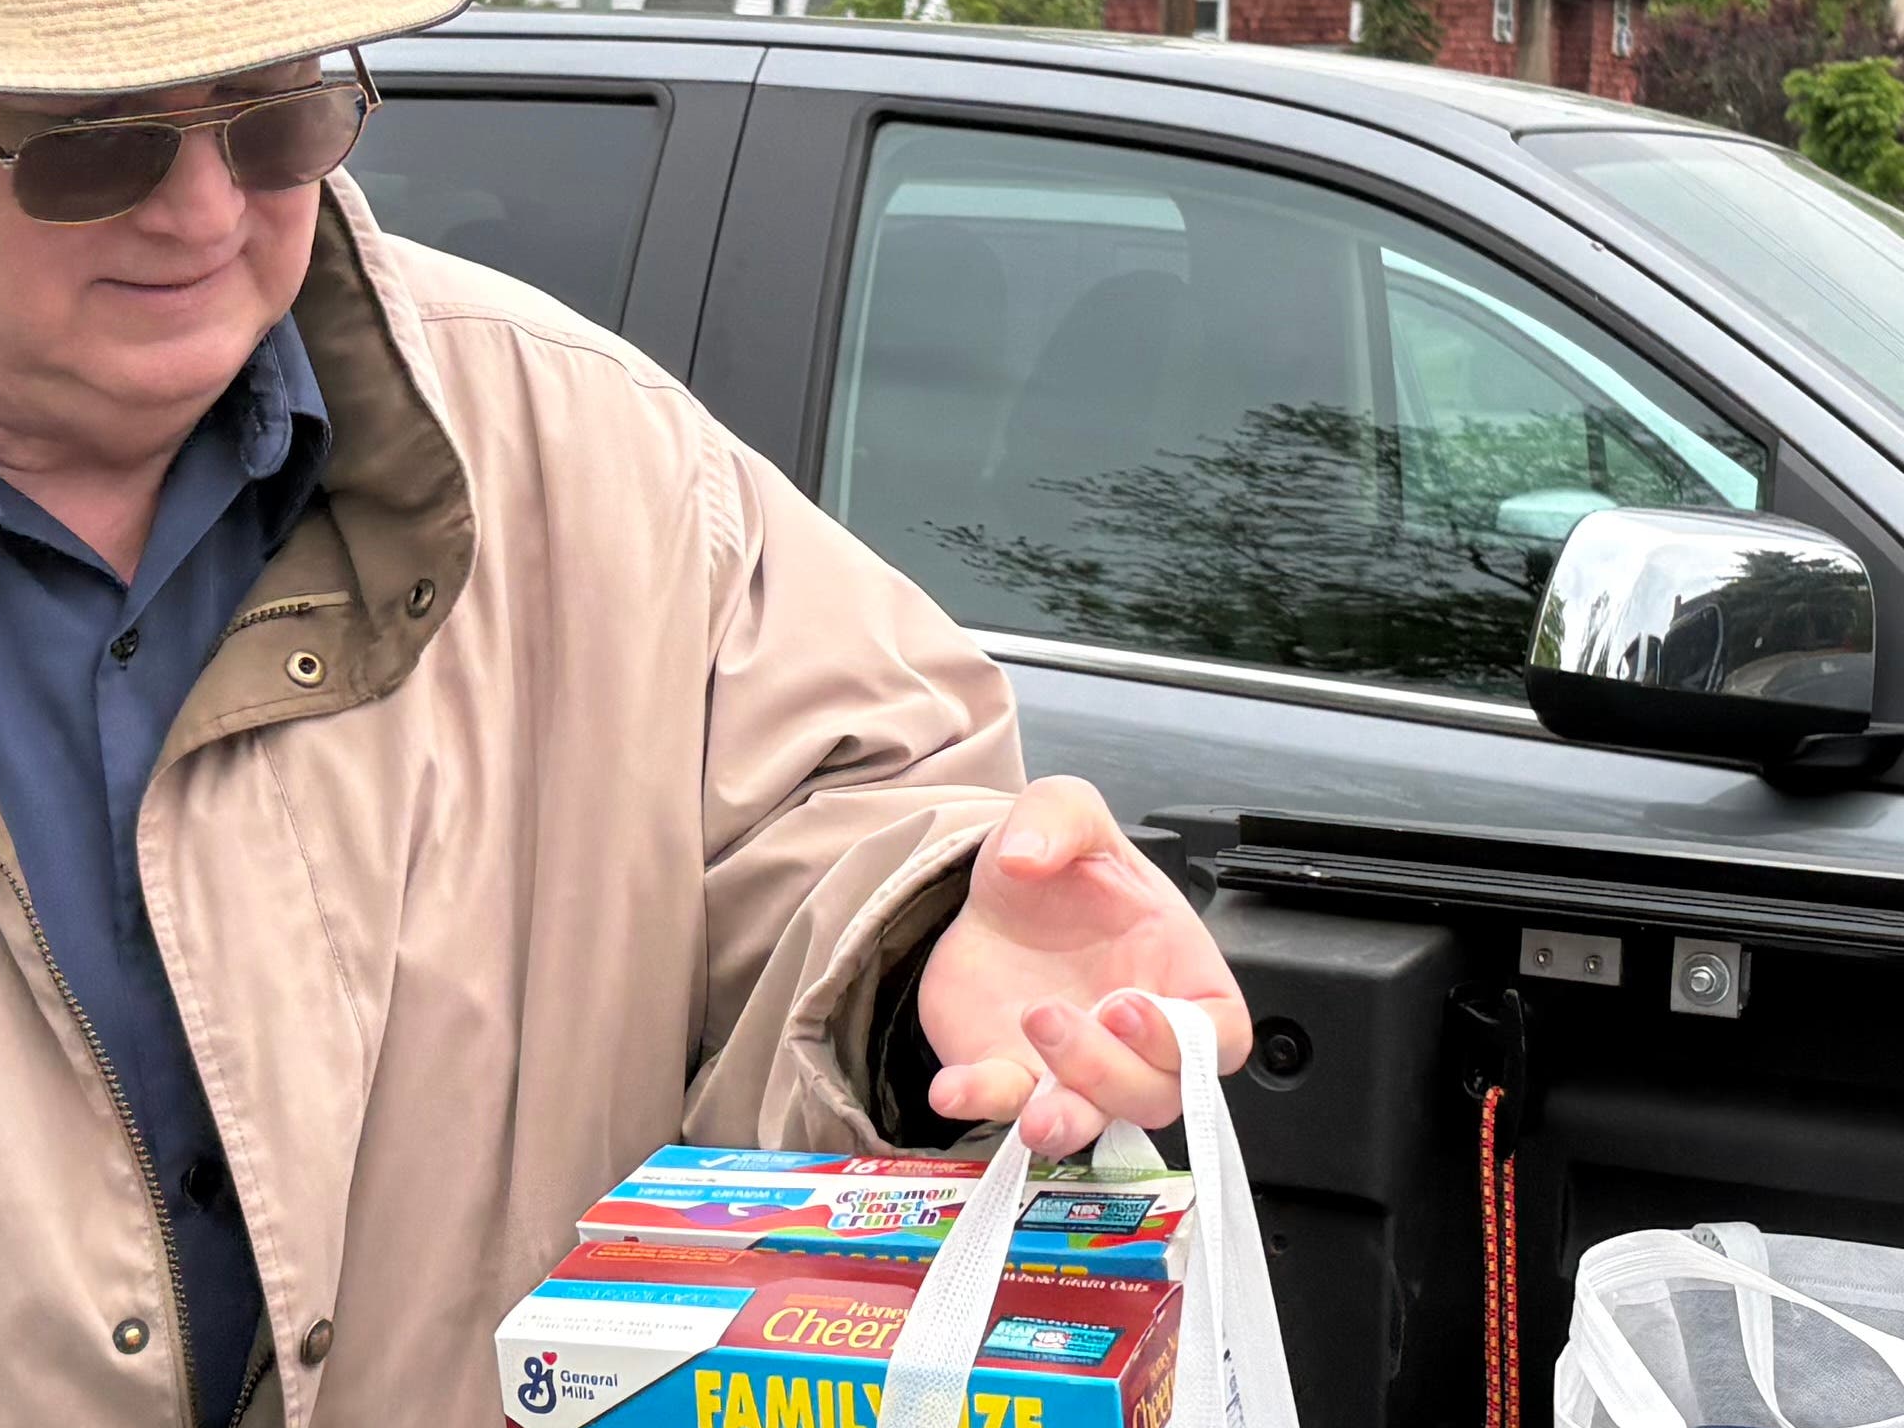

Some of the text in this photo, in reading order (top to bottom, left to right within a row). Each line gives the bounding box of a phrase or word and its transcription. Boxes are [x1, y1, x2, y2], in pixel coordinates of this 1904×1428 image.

[836, 1186, 958, 1204] Cinnamon
[851, 1200, 925, 1213] Toast
[829, 1209, 938, 1228] Crunch
[762, 1307, 901, 1350] Cheer
[559, 1369, 618, 1388] General
[561, 1385, 595, 1401] Mills
